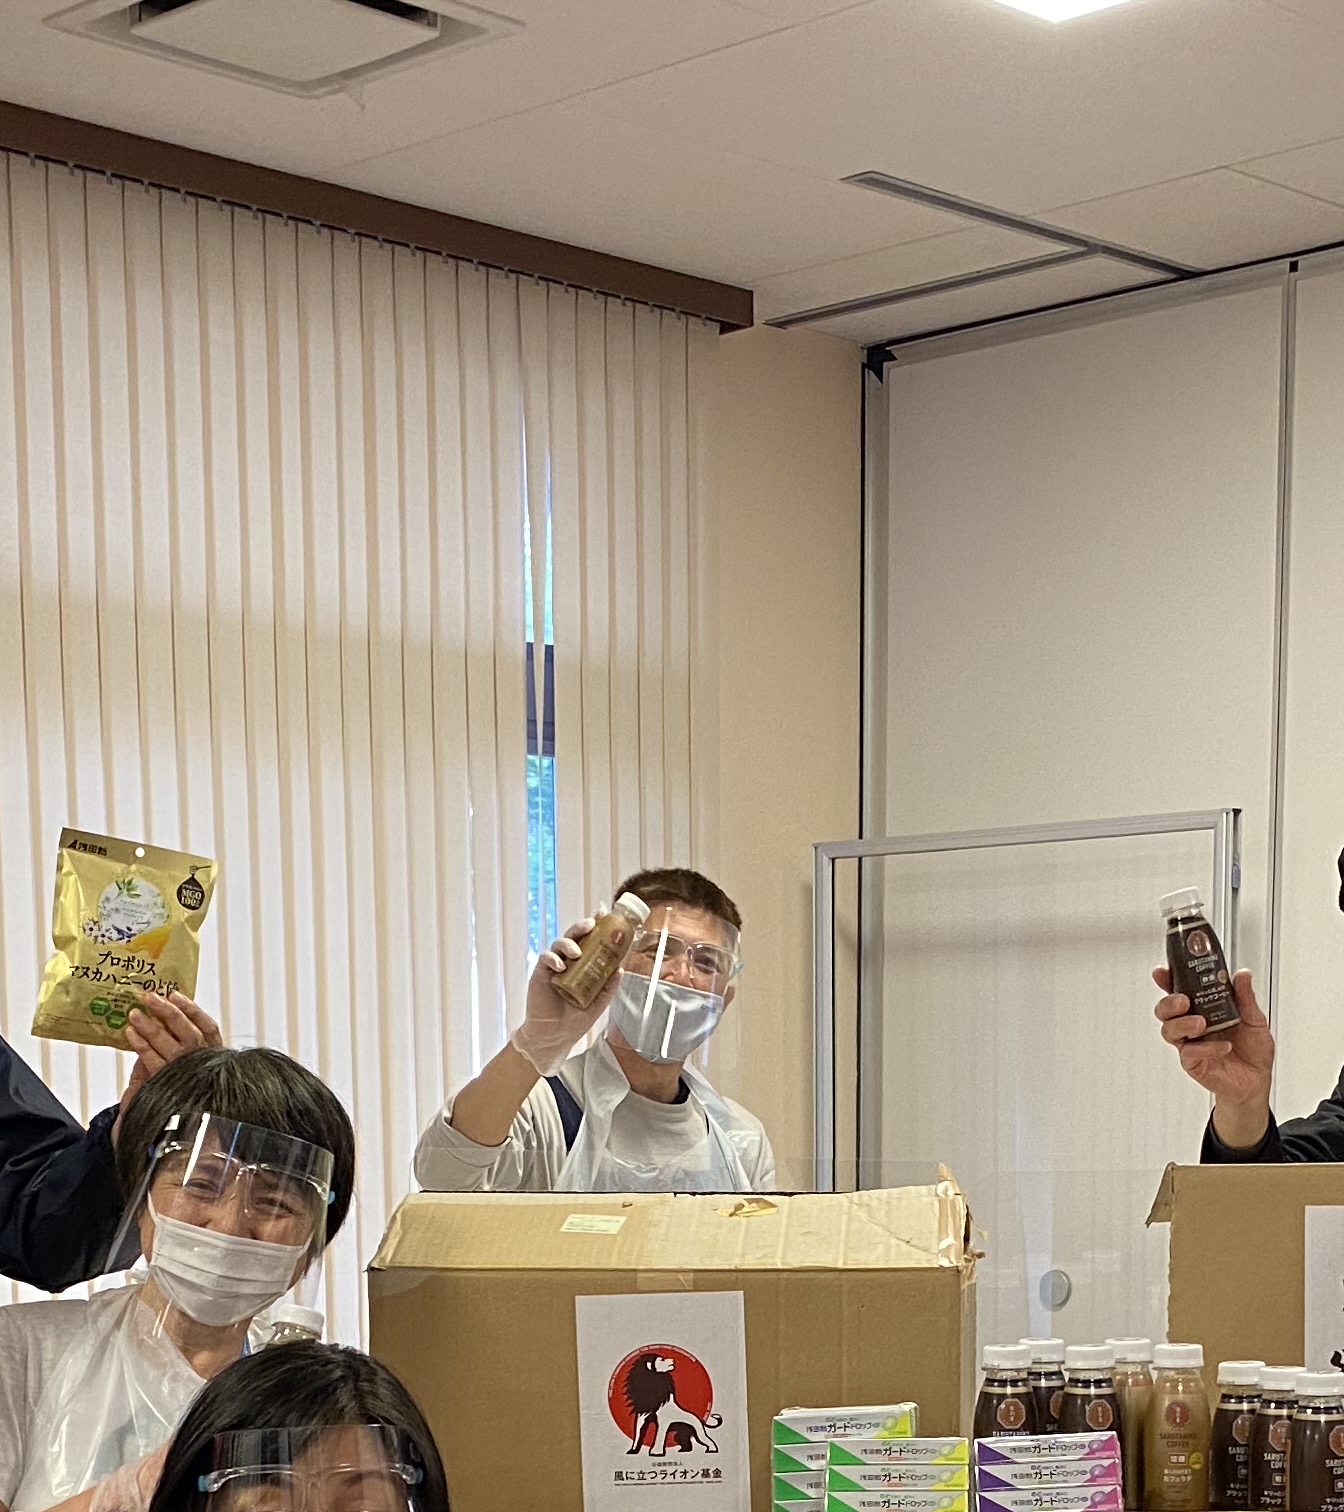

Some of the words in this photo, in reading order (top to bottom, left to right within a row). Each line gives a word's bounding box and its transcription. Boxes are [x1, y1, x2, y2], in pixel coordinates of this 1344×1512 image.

[181, 888, 202, 901] MGO
[97, 951, 156, 976] プロポリス
[614, 1468, 723, 1481] 風に立つライオン基金
